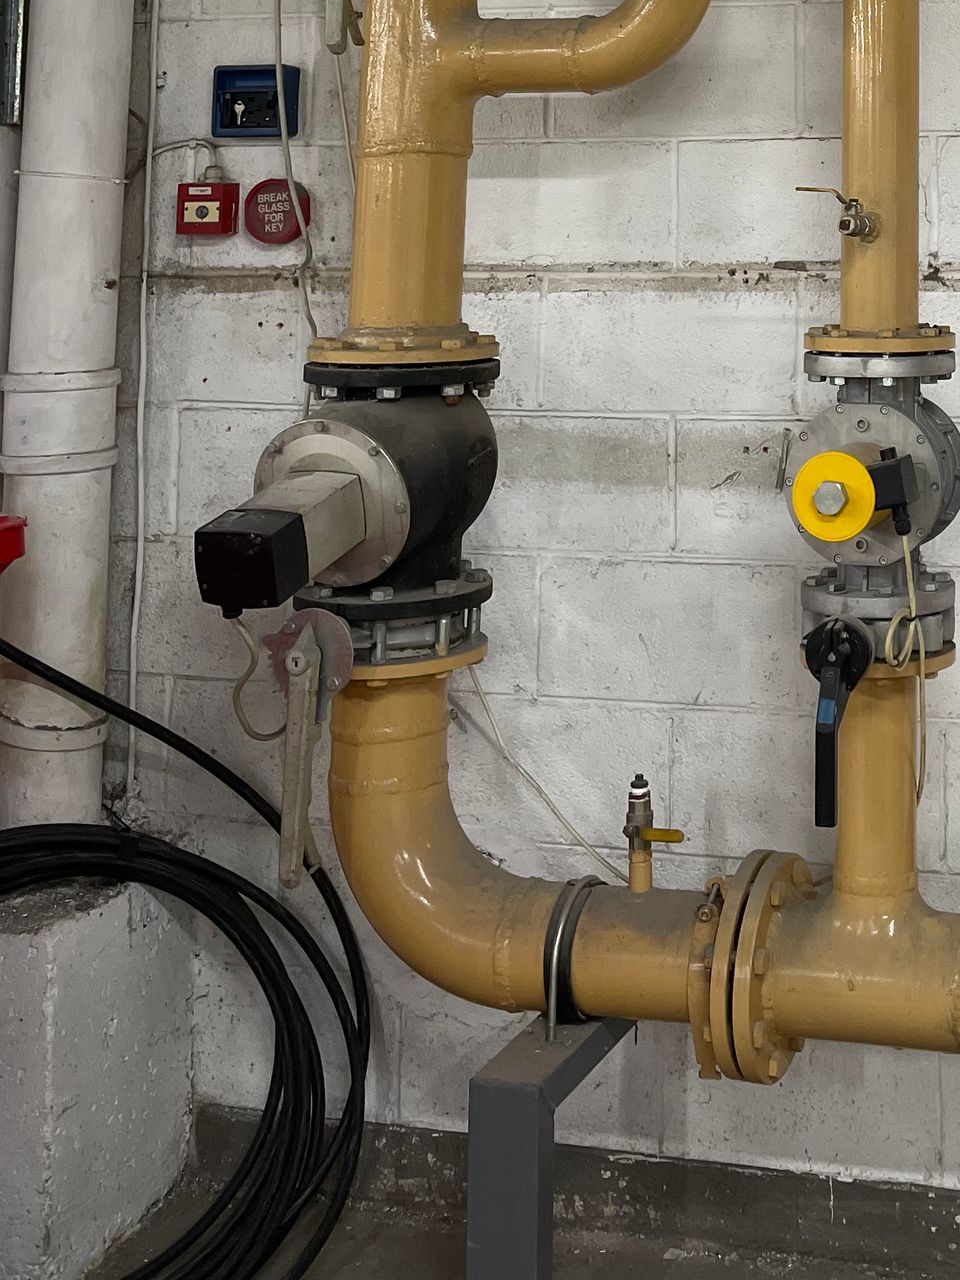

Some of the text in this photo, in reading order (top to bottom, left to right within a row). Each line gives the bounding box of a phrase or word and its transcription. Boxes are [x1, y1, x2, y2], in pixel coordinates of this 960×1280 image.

[257, 191, 289, 203] BREAK
[258, 201, 290, 213] GLASS
[264, 213, 284, 223] FOR
[264, 223, 284, 233] KEY
